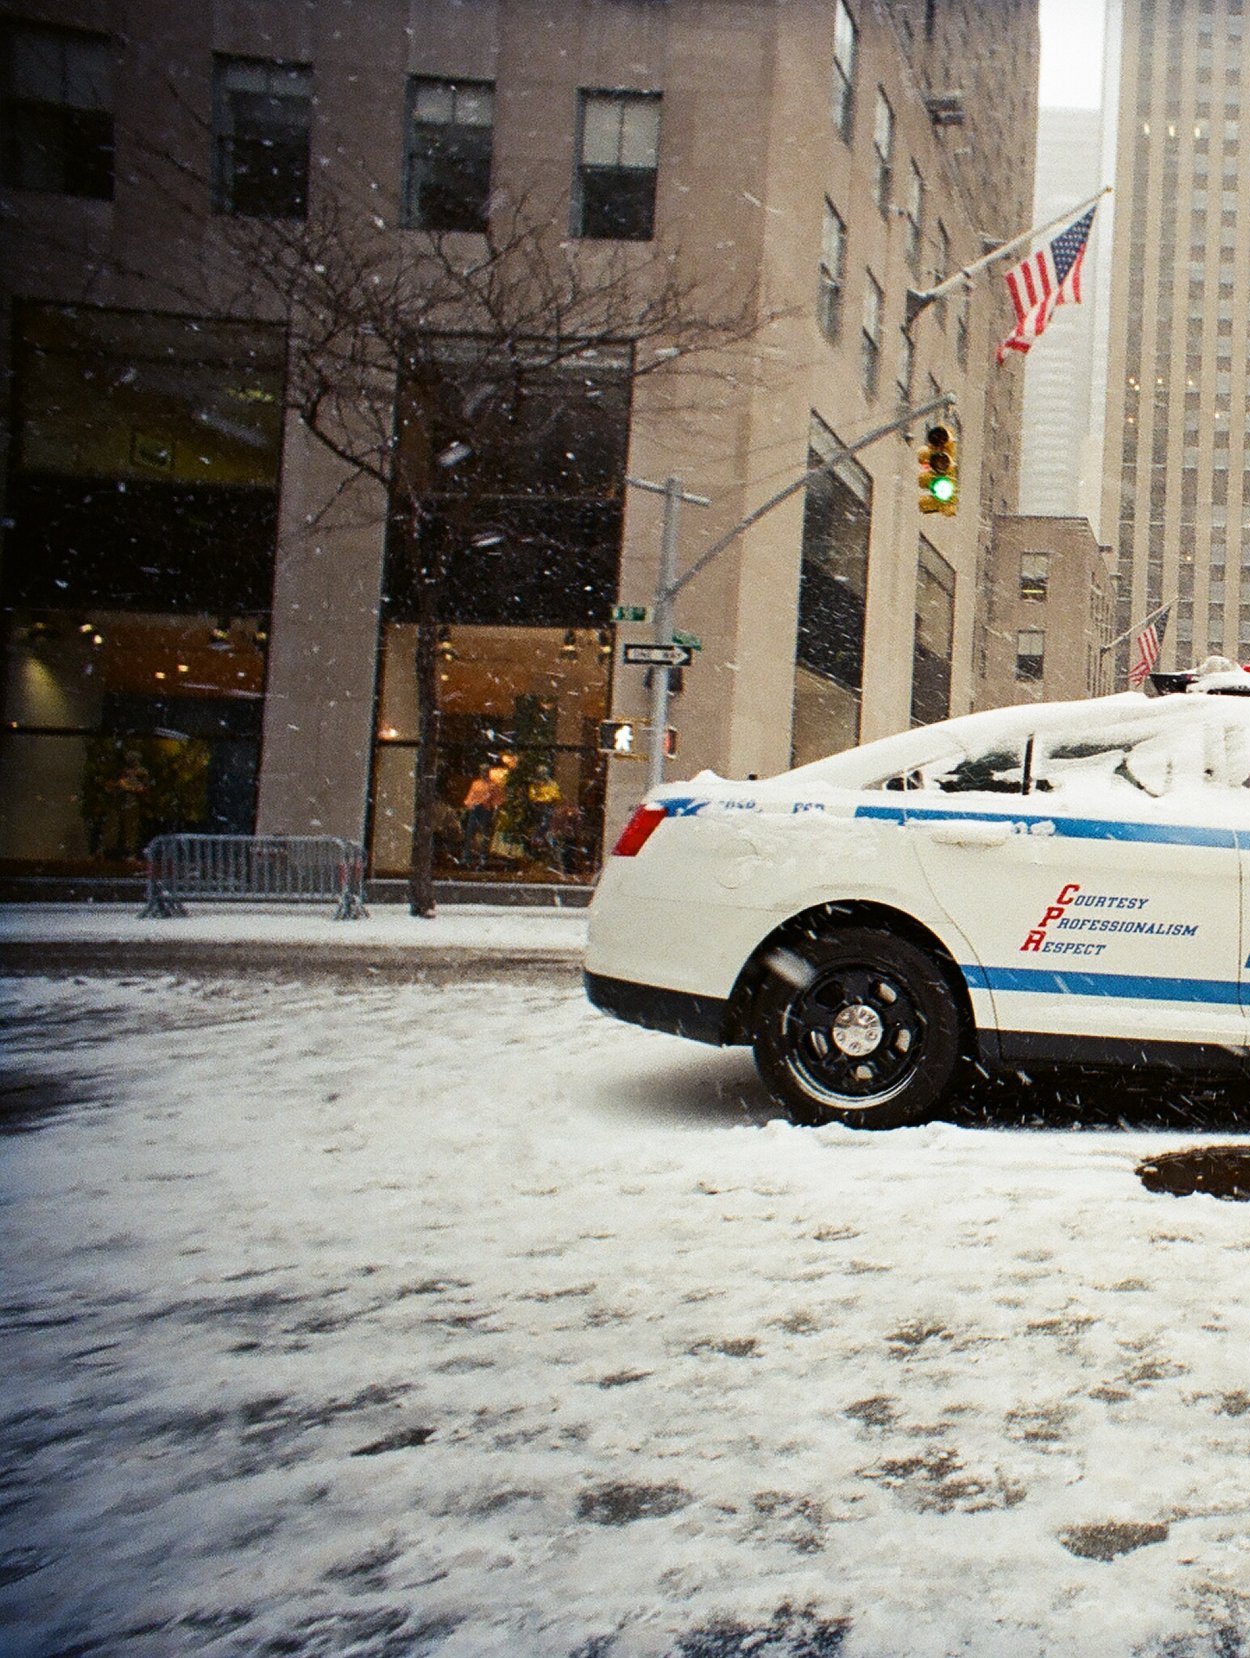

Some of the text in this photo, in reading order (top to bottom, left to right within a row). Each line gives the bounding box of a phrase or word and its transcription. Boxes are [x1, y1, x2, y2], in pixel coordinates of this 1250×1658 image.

[1056, 884, 1149, 909] COURTESY
[1038, 907, 1199, 936] PROFESSIONALISM
[1019, 930, 1107, 955] RESPECT
